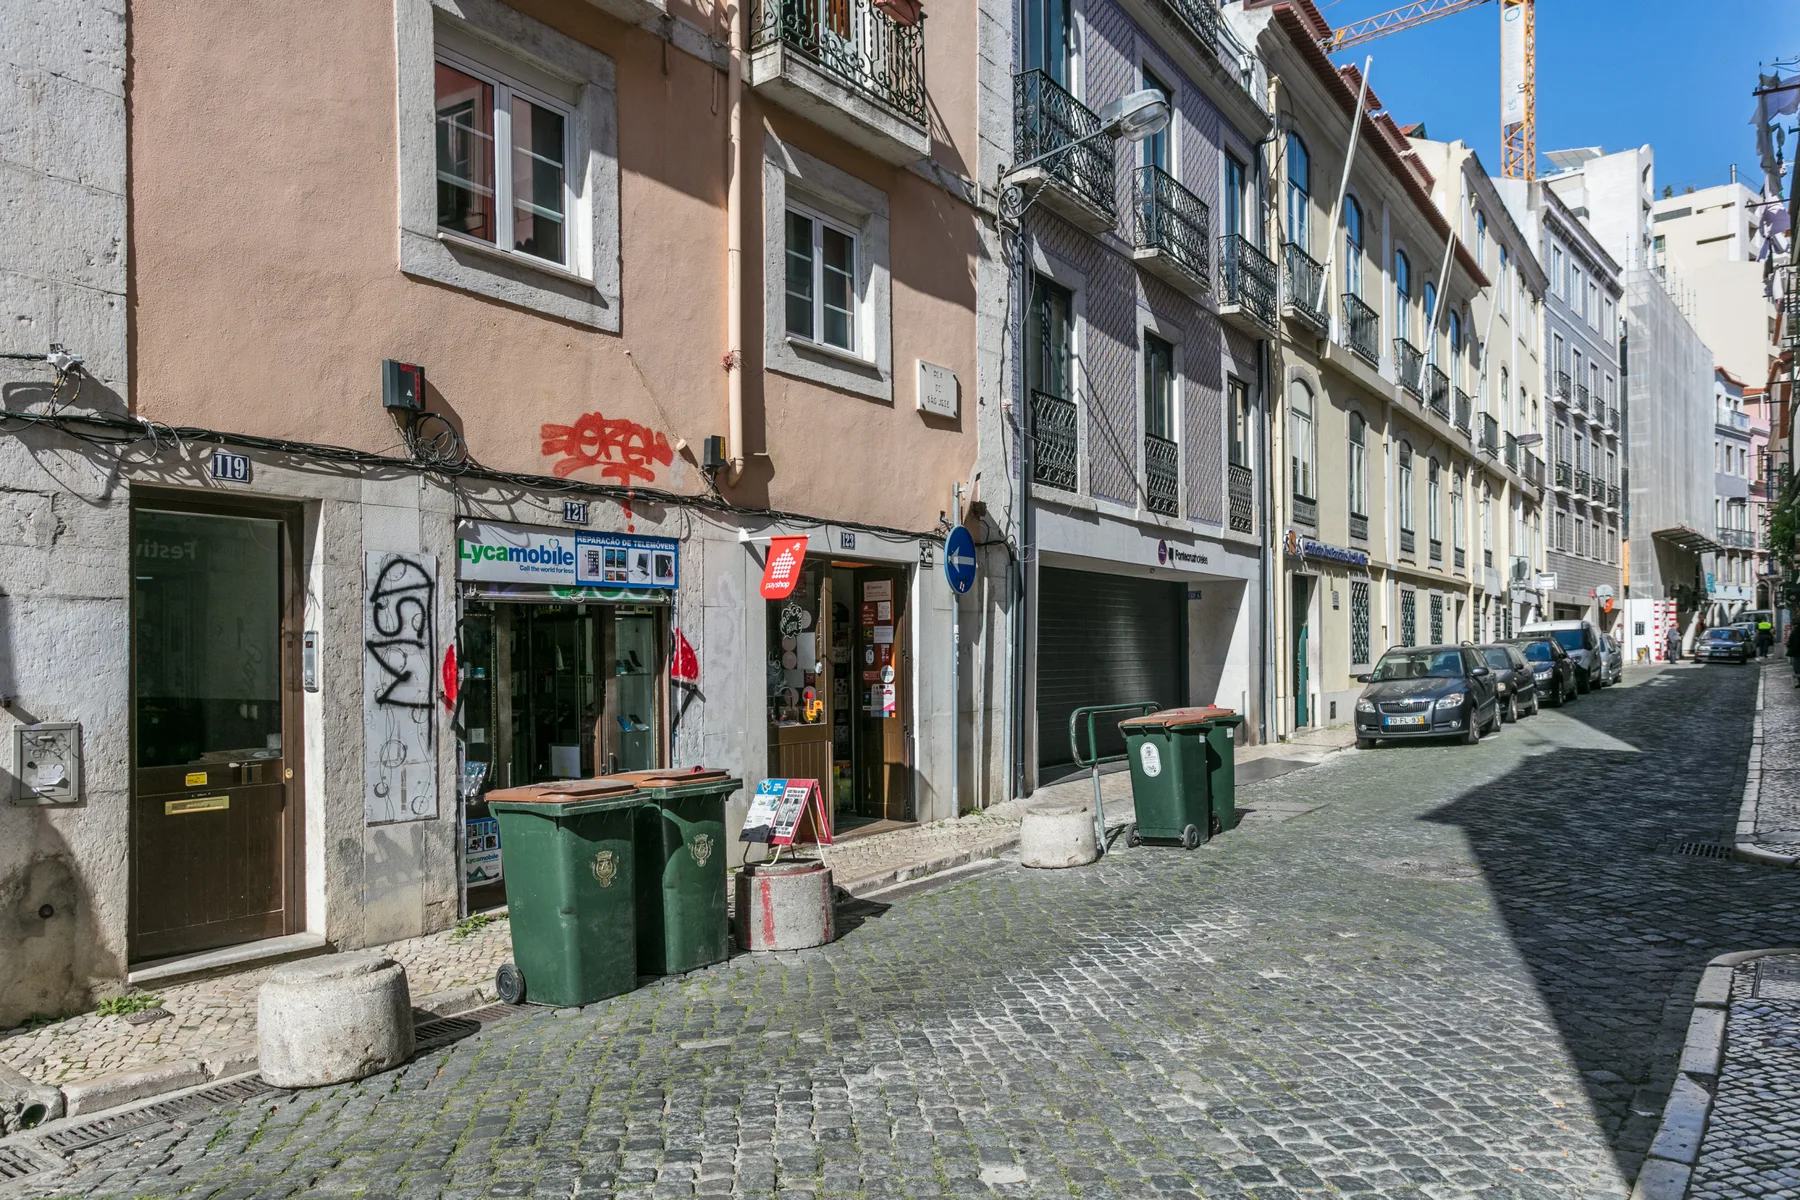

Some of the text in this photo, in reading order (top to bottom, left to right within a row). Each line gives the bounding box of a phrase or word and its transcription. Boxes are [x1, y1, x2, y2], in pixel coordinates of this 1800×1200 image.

[215, 452, 246, 480] 119
[566, 503, 585, 522] 121
[621, 539, 632, 547] DE
[634, 540, 675, 550] TELEMÓVEIS
[842, 533, 854, 548] 123
[459, 538, 574, 566] Lycamobile
[555, 566, 564, 574] for
[764, 581, 790, 590] payshop
[466, 853, 499, 864] Lycamobile
